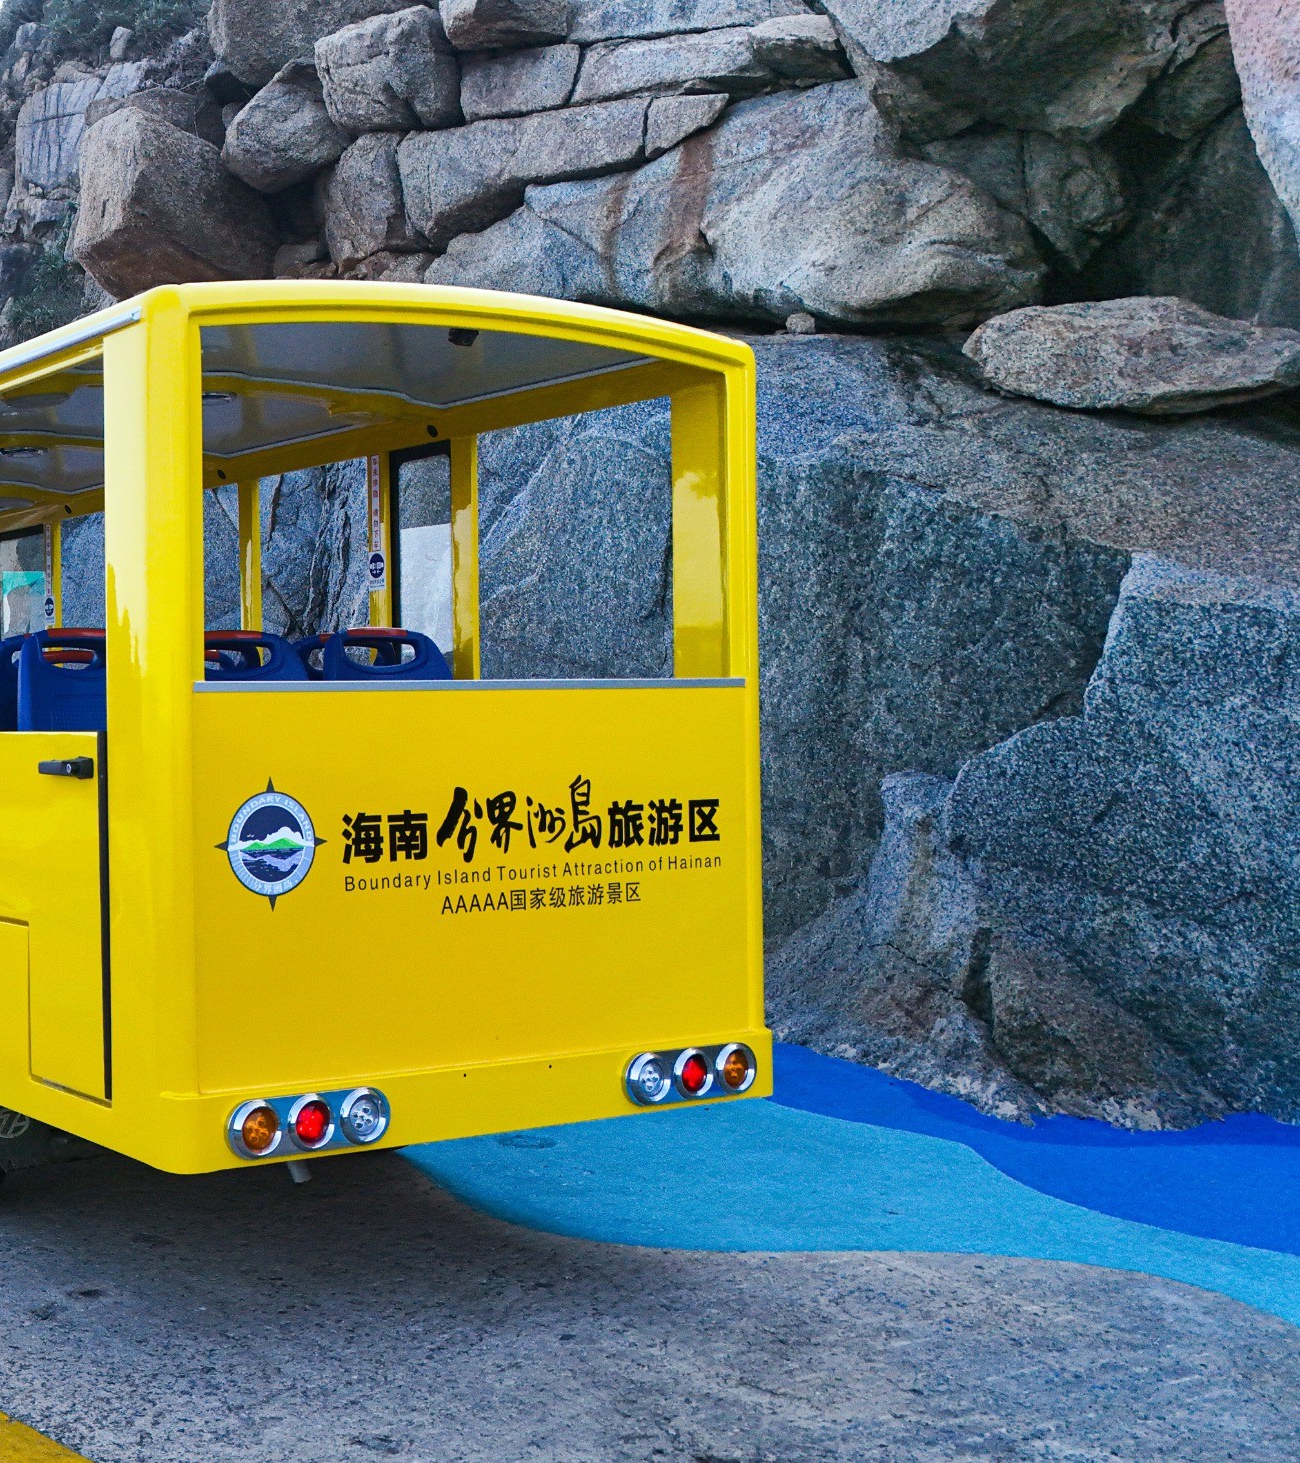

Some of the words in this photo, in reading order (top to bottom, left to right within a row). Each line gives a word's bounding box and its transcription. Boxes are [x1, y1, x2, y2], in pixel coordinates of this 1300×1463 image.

[231, 796, 281, 843] BOUNDARY
[284, 800, 312, 840] ISLAND
[345, 873, 431, 891] Boundary
[438, 867, 491, 885] Island
[496, 863, 557, 881] Tourist
[562, 858, 643, 877] Attraction
[649, 856, 663, 871] of
[668, 855, 721, 870] Hainan
